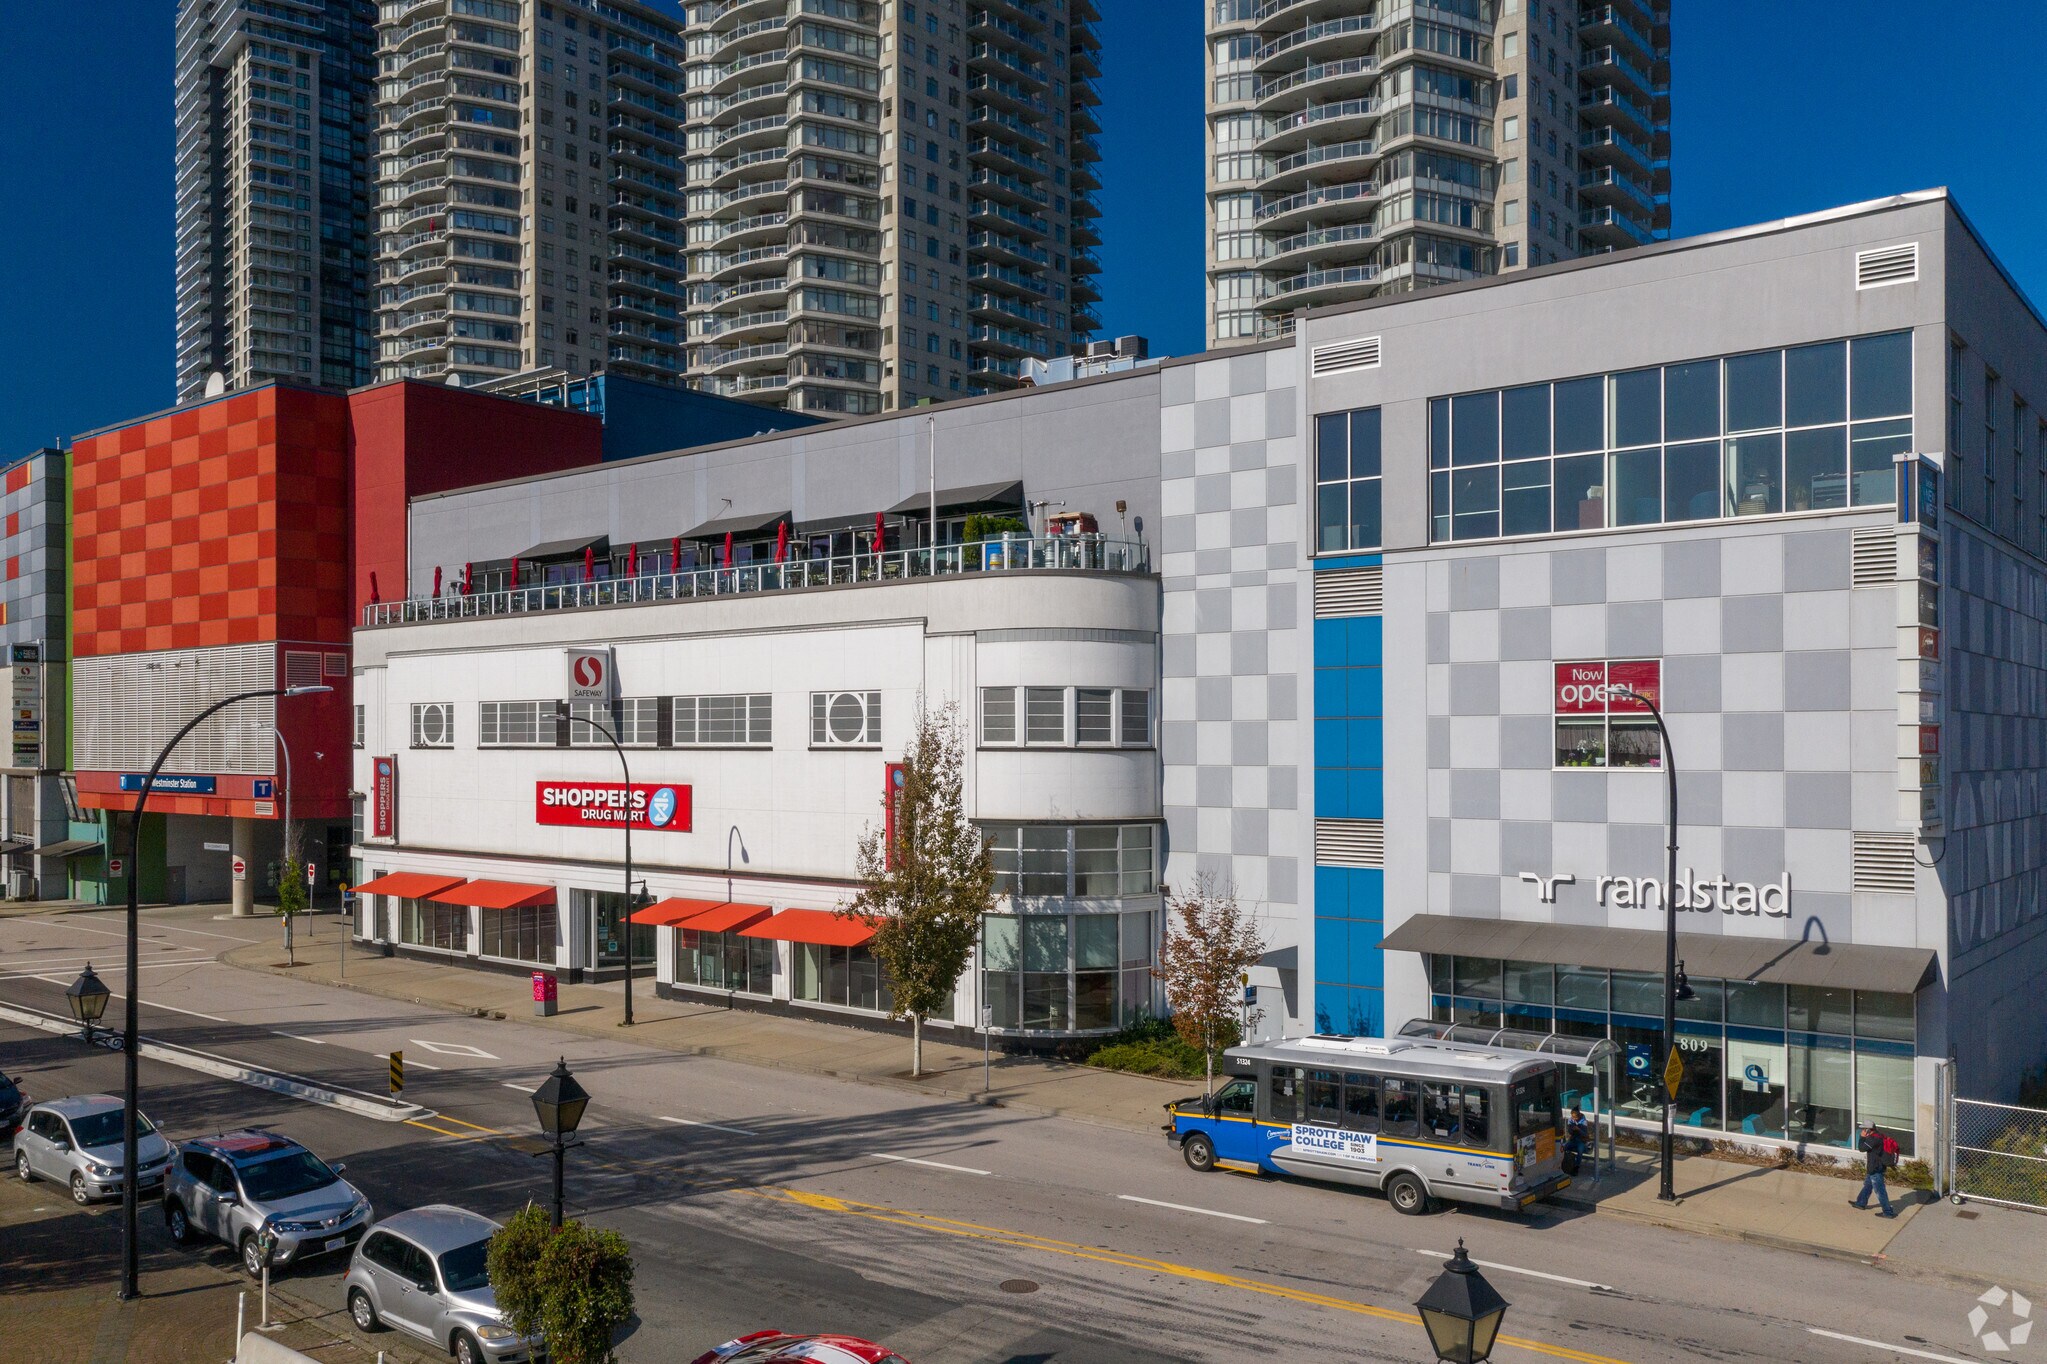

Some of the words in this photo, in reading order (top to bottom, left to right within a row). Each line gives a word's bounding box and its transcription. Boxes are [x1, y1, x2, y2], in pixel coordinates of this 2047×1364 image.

[1572, 668, 1603, 681] Now
[574, 689, 603, 697] SAFEWAY
[1561, 682, 1633, 709] open!
[180, 778, 197, 789] Station
[542, 787, 646, 808] SHOPPERS
[581, 808, 612, 820] DRUG
[613, 810, 646, 822] MART
[1596, 867, 1789, 914] randstad
[1680, 1037, 1708, 1052] 809
[1295, 1125, 1337, 1139] SPROTT
[1338, 1131, 1372, 1144] SHAW
[1295, 1135, 1345, 1151] COLLEGE
